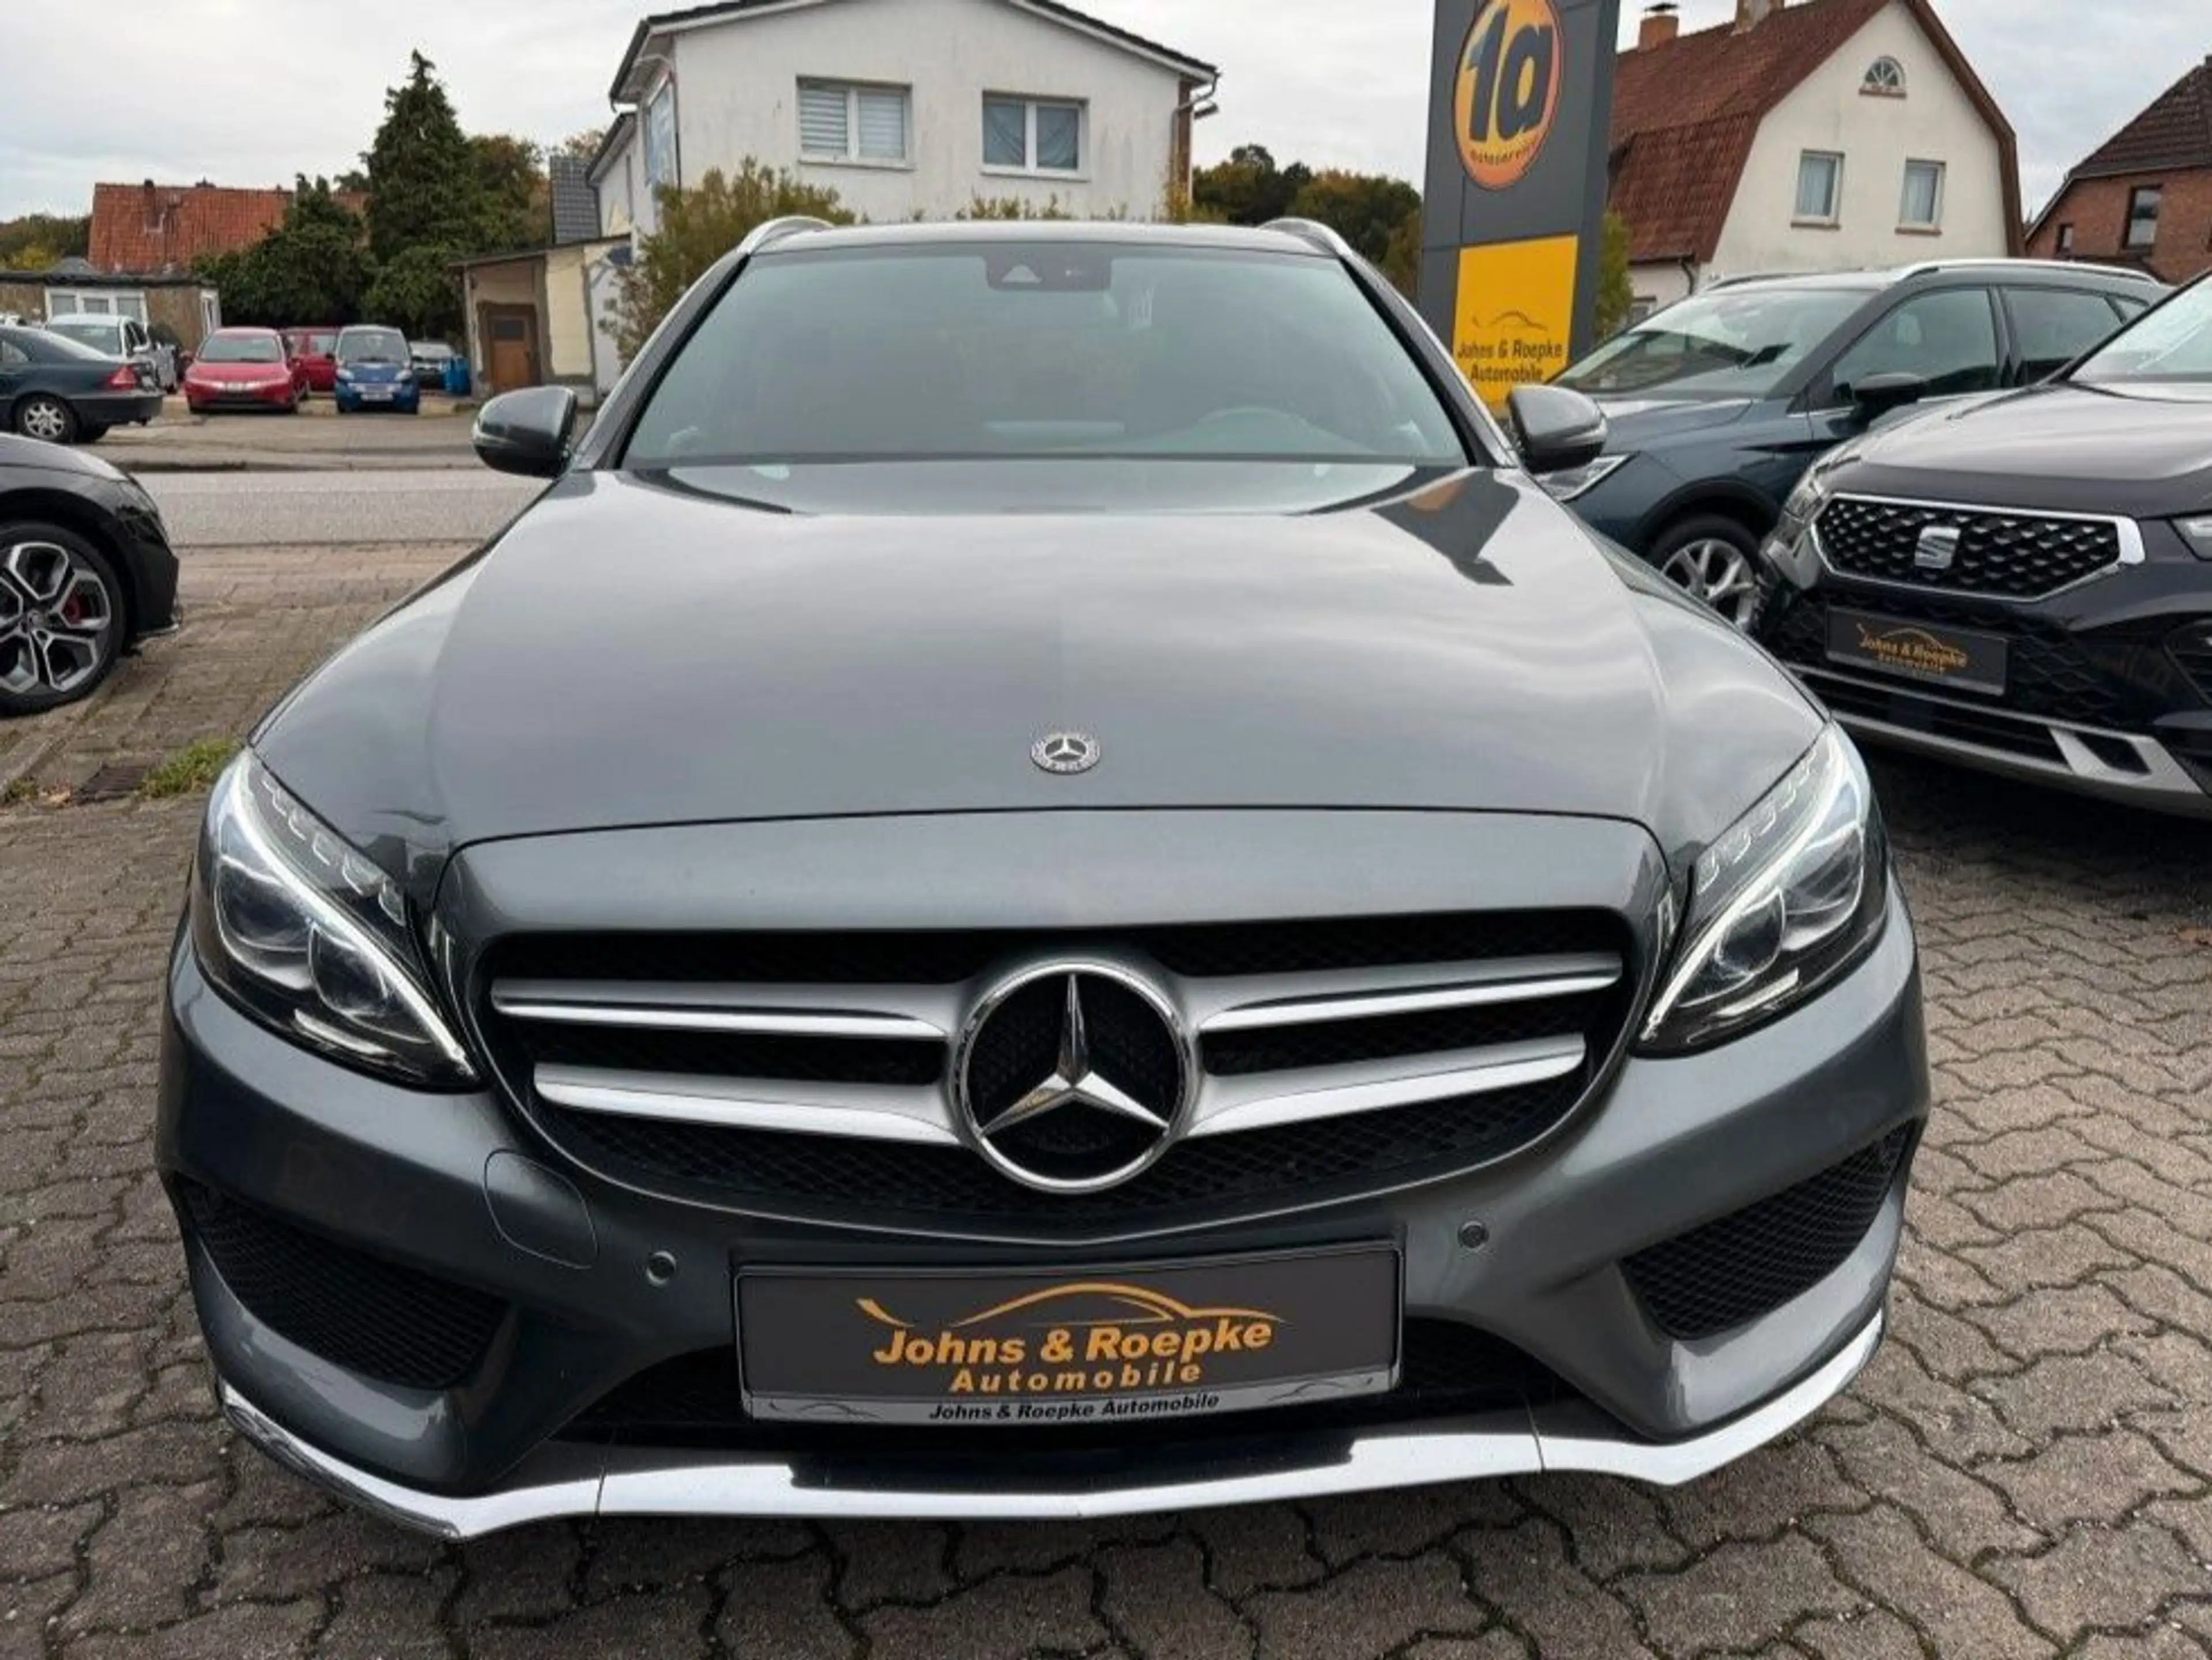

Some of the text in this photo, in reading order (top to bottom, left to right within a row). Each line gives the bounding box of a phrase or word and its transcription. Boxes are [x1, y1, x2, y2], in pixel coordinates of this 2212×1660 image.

[1458, 339, 1562, 361] Johns & Roepke
[1471, 364, 1544, 382] Automobile
[873, 1318, 1272, 1364] Johns & Roepke
[948, 1360, 1201, 1393] Automobile
[929, 1394, 1219, 1421] Johns & Roepke Automobile
